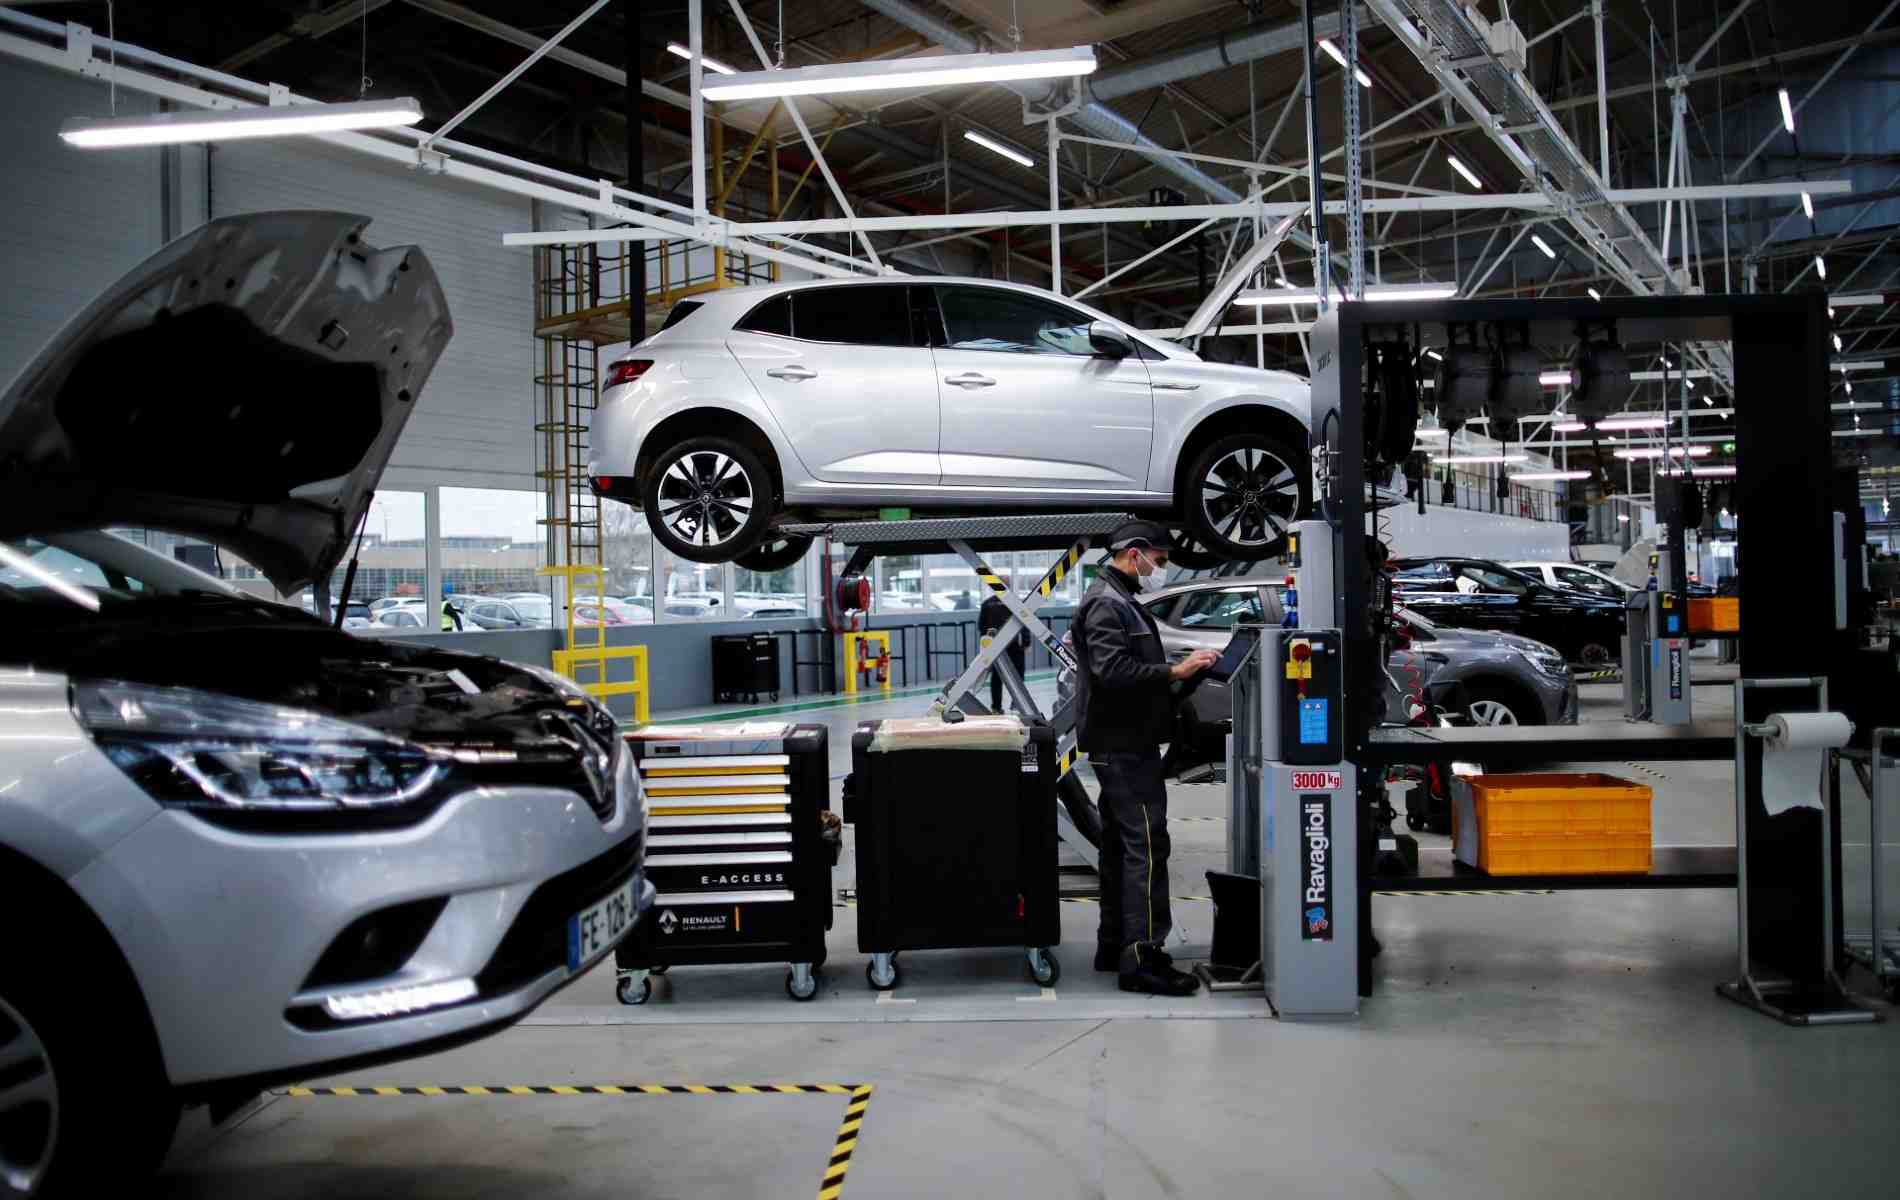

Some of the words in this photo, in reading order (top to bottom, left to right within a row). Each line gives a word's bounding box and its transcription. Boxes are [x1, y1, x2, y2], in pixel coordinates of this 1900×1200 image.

[1294, 772, 1326, 788] 3000
[1327, 772, 1340, 788] kg
[1305, 802, 1329, 904] Ravaglioli
[701, 873, 784, 885] E-ACCESS
[682, 916, 727, 925] RENAULT
